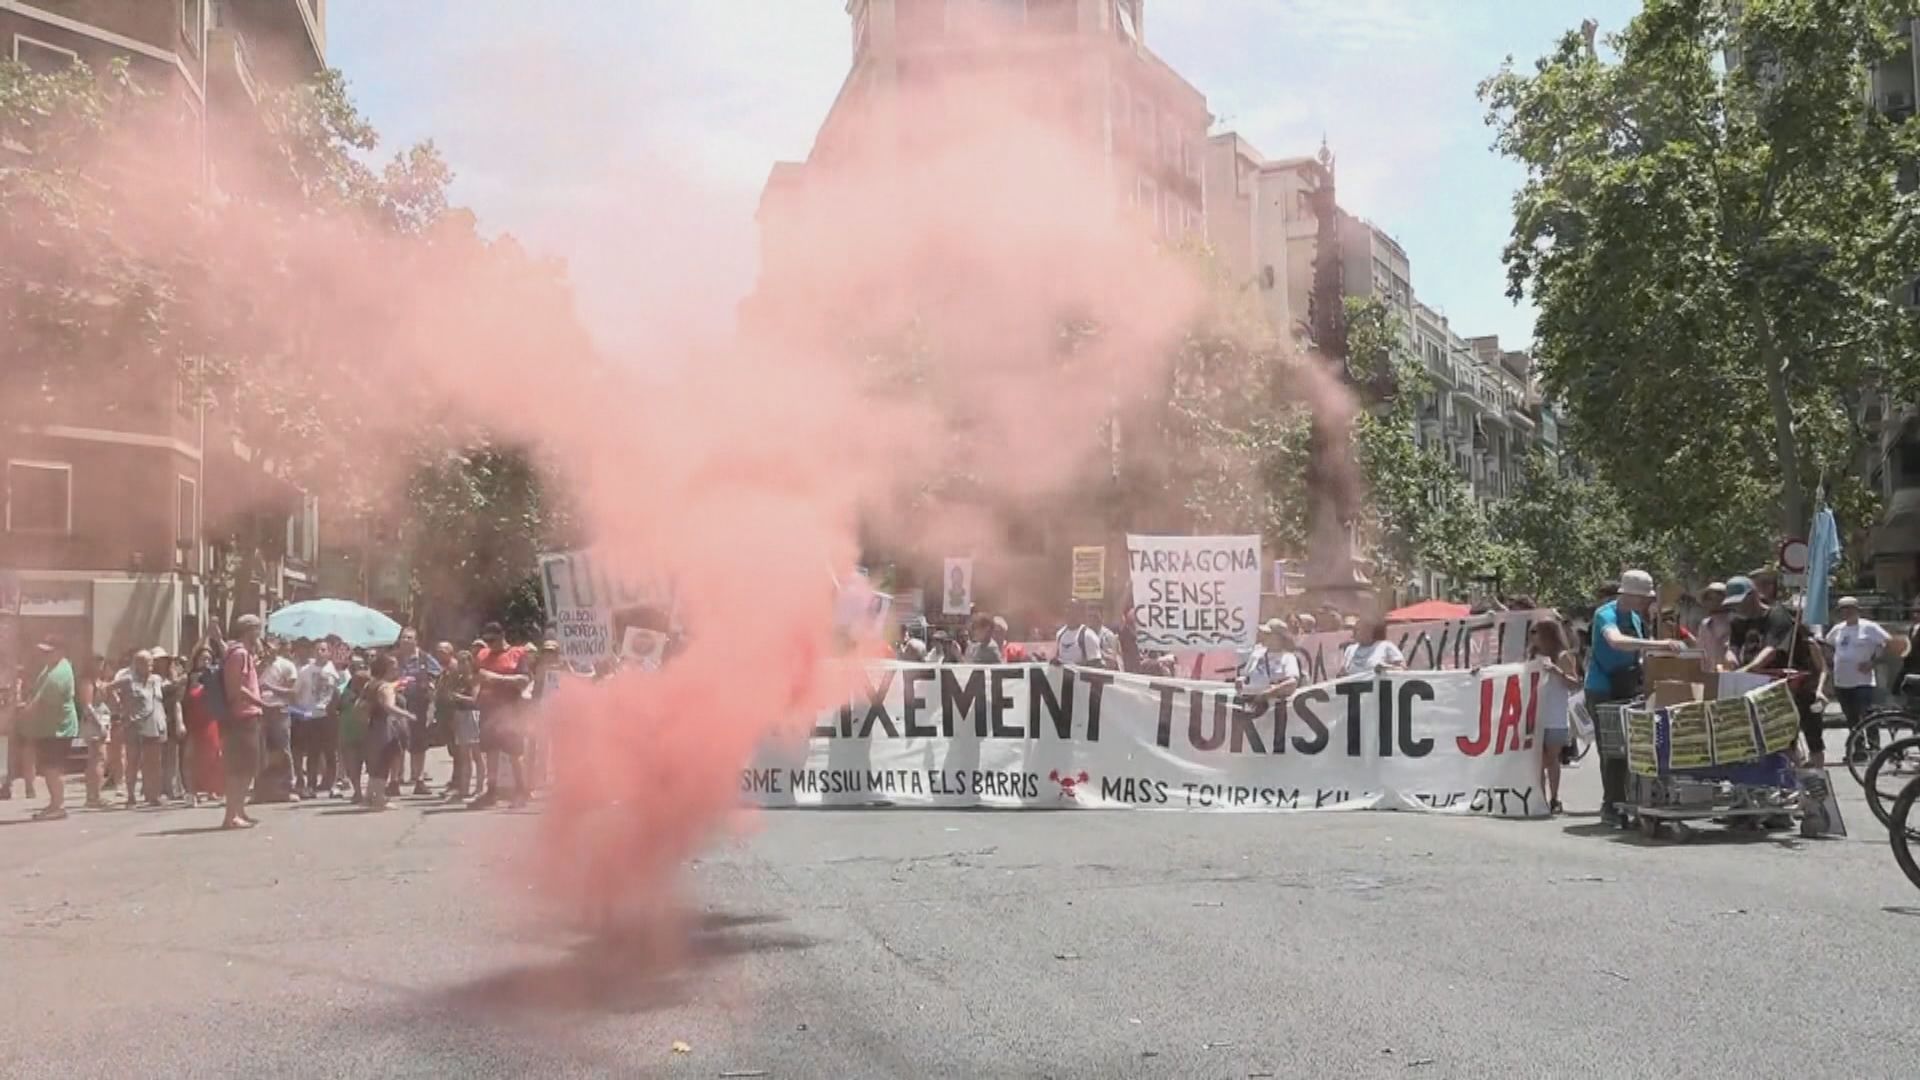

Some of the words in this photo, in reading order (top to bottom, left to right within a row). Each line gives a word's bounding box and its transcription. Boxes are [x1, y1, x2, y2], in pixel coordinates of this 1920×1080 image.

[1128, 548, 1257, 572] TARRAGONA
[1149, 578, 1226, 605] SENSE
[1135, 604, 1245, 632] CREUERS
[810, 667, 1114, 742] IXEMENT
[1150, 680, 1434, 757] TURISTIC
[1456, 672, 1540, 757] JA!
[740, 768, 782, 793] SME
[790, 768, 861, 793] MASSIU
[867, 769, 923, 794] MATA
[929, 770, 966, 795] ELS
[972, 771, 1039, 798] BARRIS
[1102, 776, 1168, 804] MASS
[1470, 786, 1532, 815] CITY
